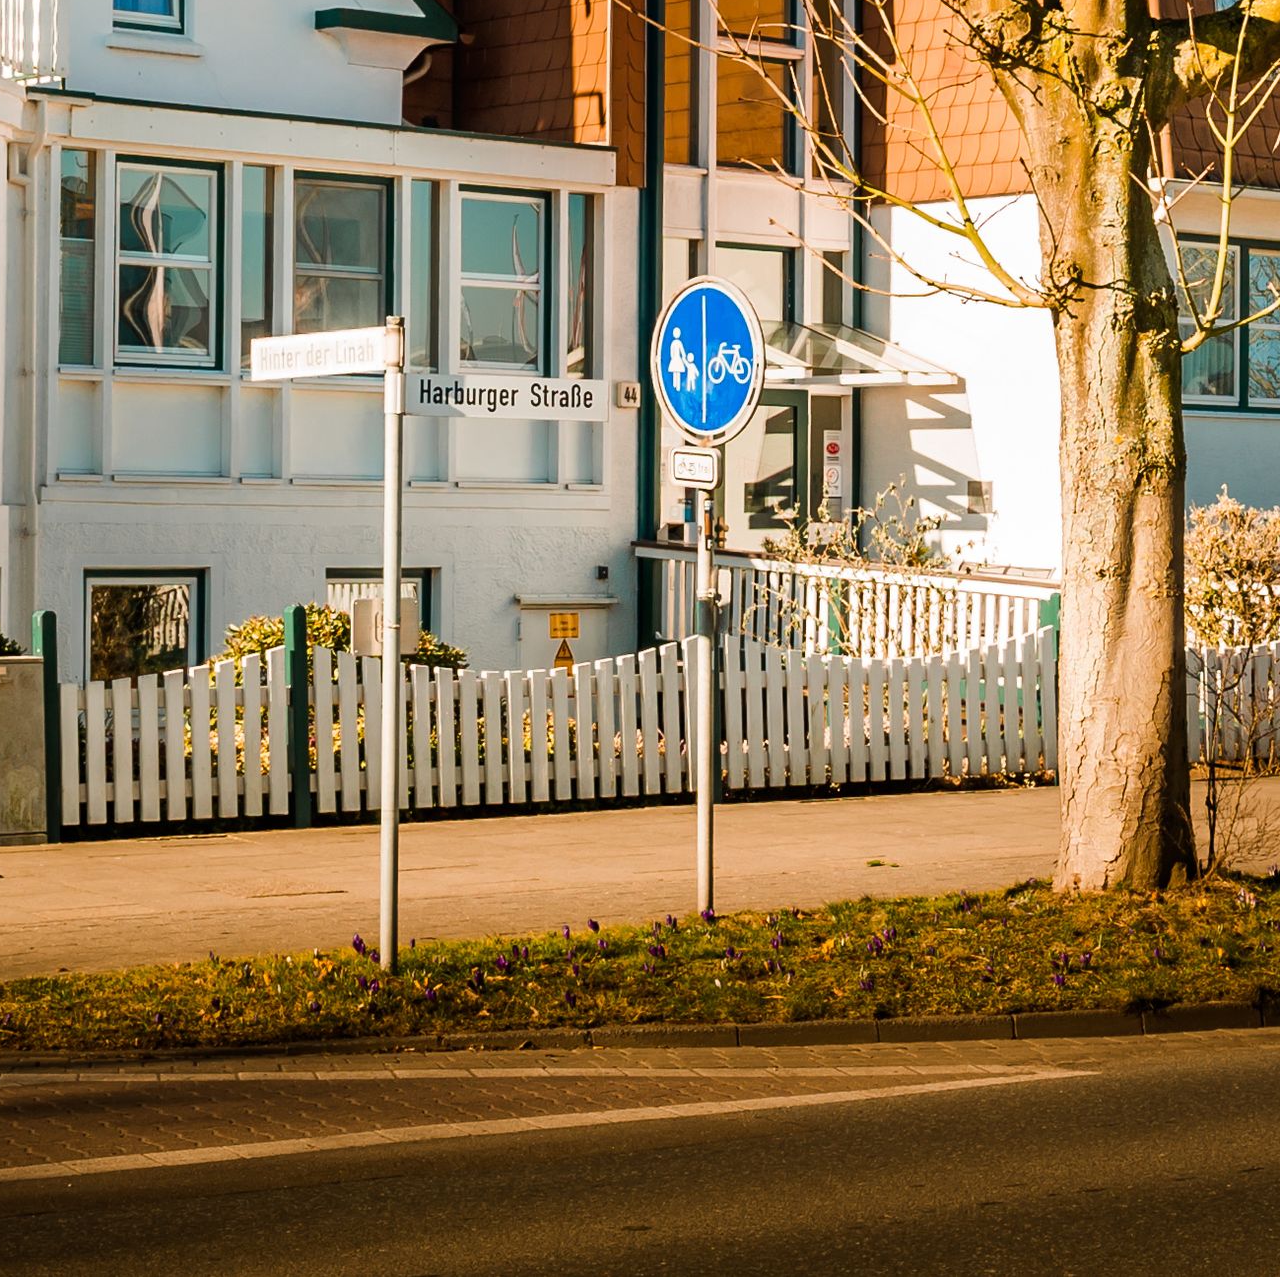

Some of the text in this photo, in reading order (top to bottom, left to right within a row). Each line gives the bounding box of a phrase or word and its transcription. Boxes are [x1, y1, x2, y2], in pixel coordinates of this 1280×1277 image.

[259, 337, 375, 371] Hinter der Linah
[419, 378, 593, 413] Harburger Straße
[623, 386, 638, 404] 44
